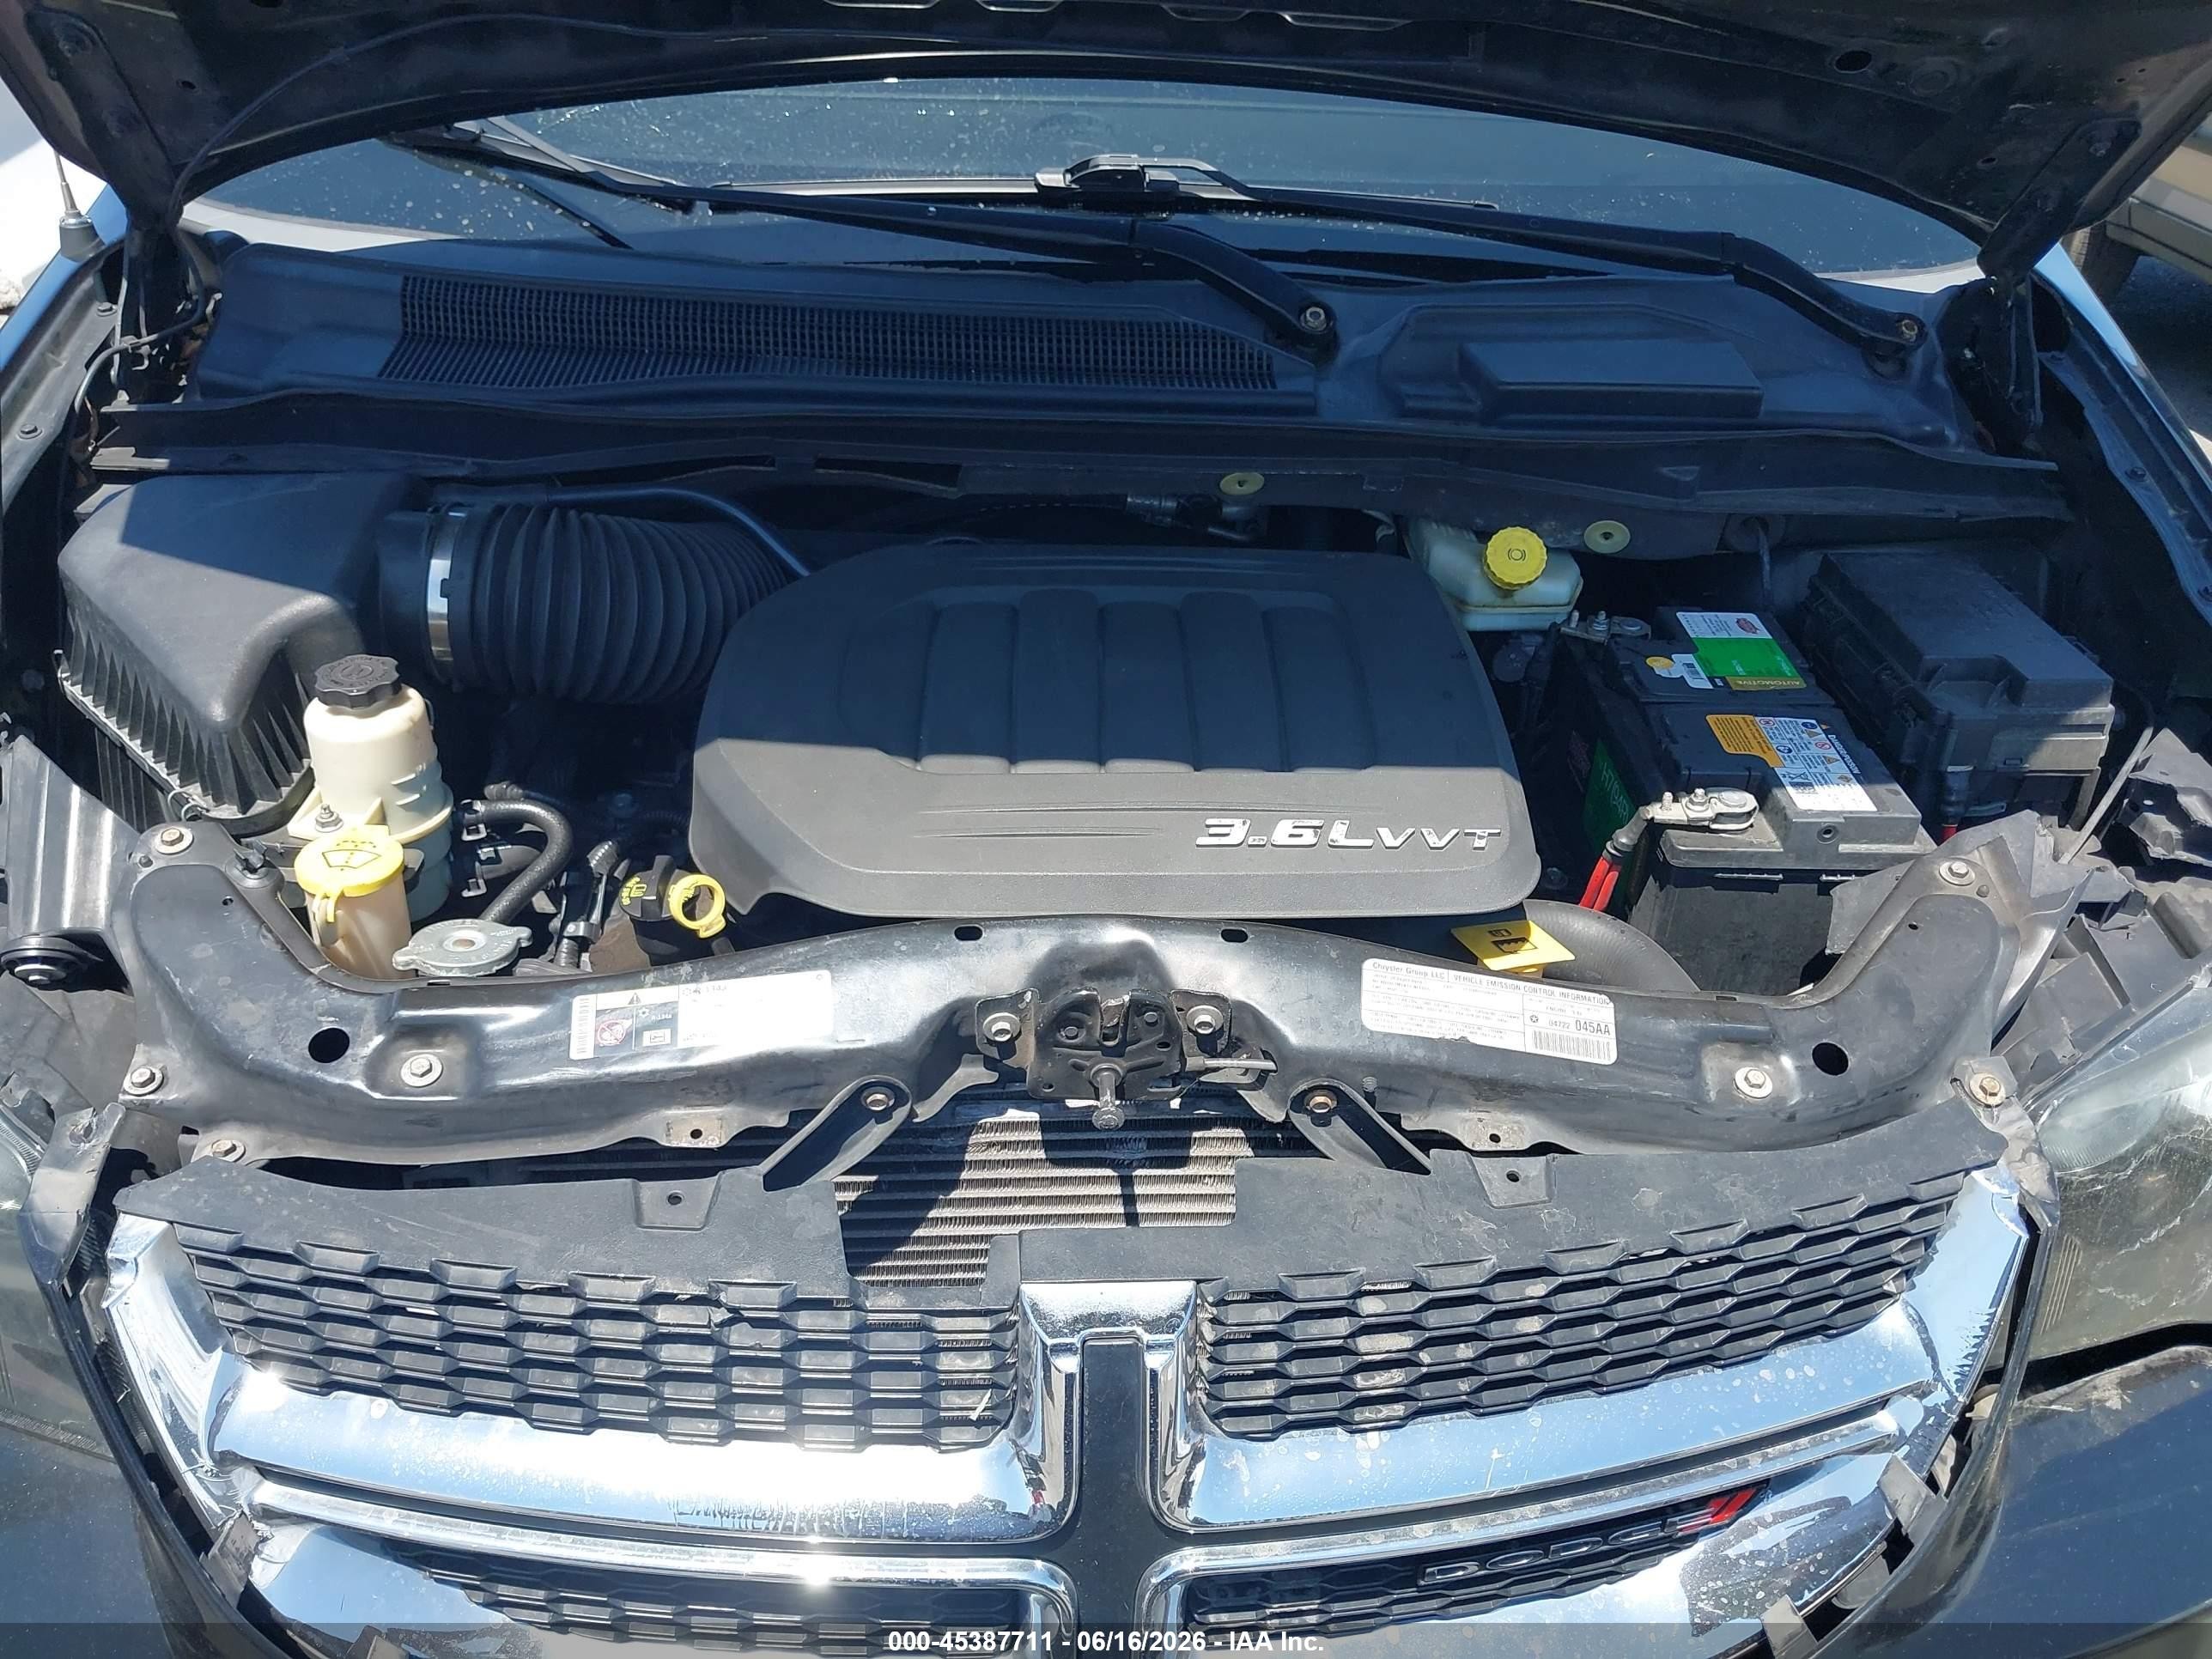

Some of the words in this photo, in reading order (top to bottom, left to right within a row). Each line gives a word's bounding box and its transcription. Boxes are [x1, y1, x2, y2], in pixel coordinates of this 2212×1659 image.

[1736, 678, 1801, 687] AUTOMOTIVE
[1195, 817, 1374, 850] 3.6L
[1376, 827, 1502, 852] VVT
[1372, 961, 1403, 974] Chrysler
[1405, 964, 1429, 979] Group
[1431, 969, 1446, 980] LLC
[1453, 974, 1484, 987] VEHICLE
[1486, 978, 1522, 992] EMISSION
[1522, 985, 1556, 998] CONTROL
[1559, 990, 1611, 1006] INFORMATION
[1575, 1019, 1611, 1036] 045AA
[1420, 1509, 1711, 1584] DODGE
